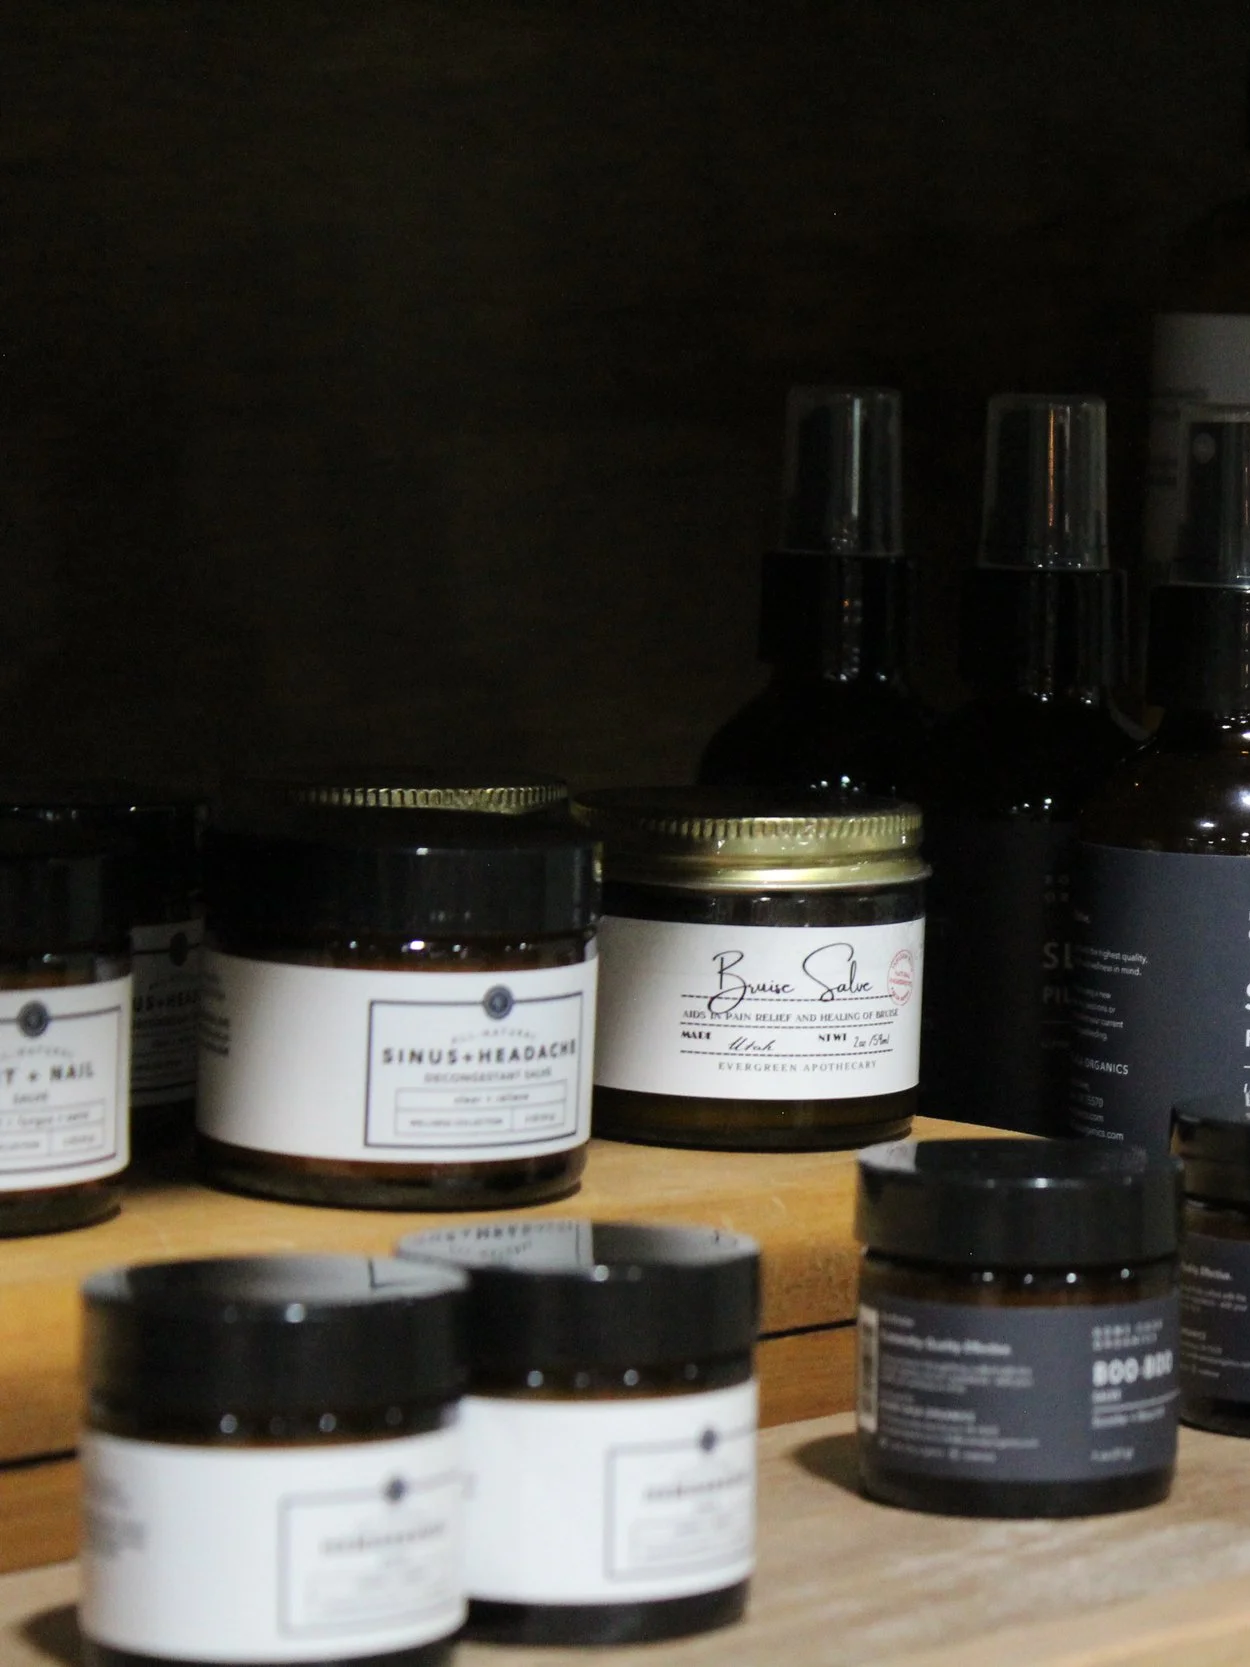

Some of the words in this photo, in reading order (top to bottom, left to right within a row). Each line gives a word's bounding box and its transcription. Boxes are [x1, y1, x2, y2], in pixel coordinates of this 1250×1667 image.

[708, 950, 795, 1014] Bruise
[802, 942, 873, 1002] Salve
[683, 1010, 706, 1020] AIDS
[726, 1012, 751, 1021] PAIN
[755, 1013, 791, 1022] RELIEF
[796, 1014, 817, 1022] AND
[820, 1012, 860, 1021] HEALING
[863, 1011, 873, 1020] OF
[718, 1061, 797, 1073] EVERGREEN
[803, 1059, 877, 1073] APOTHECARY
